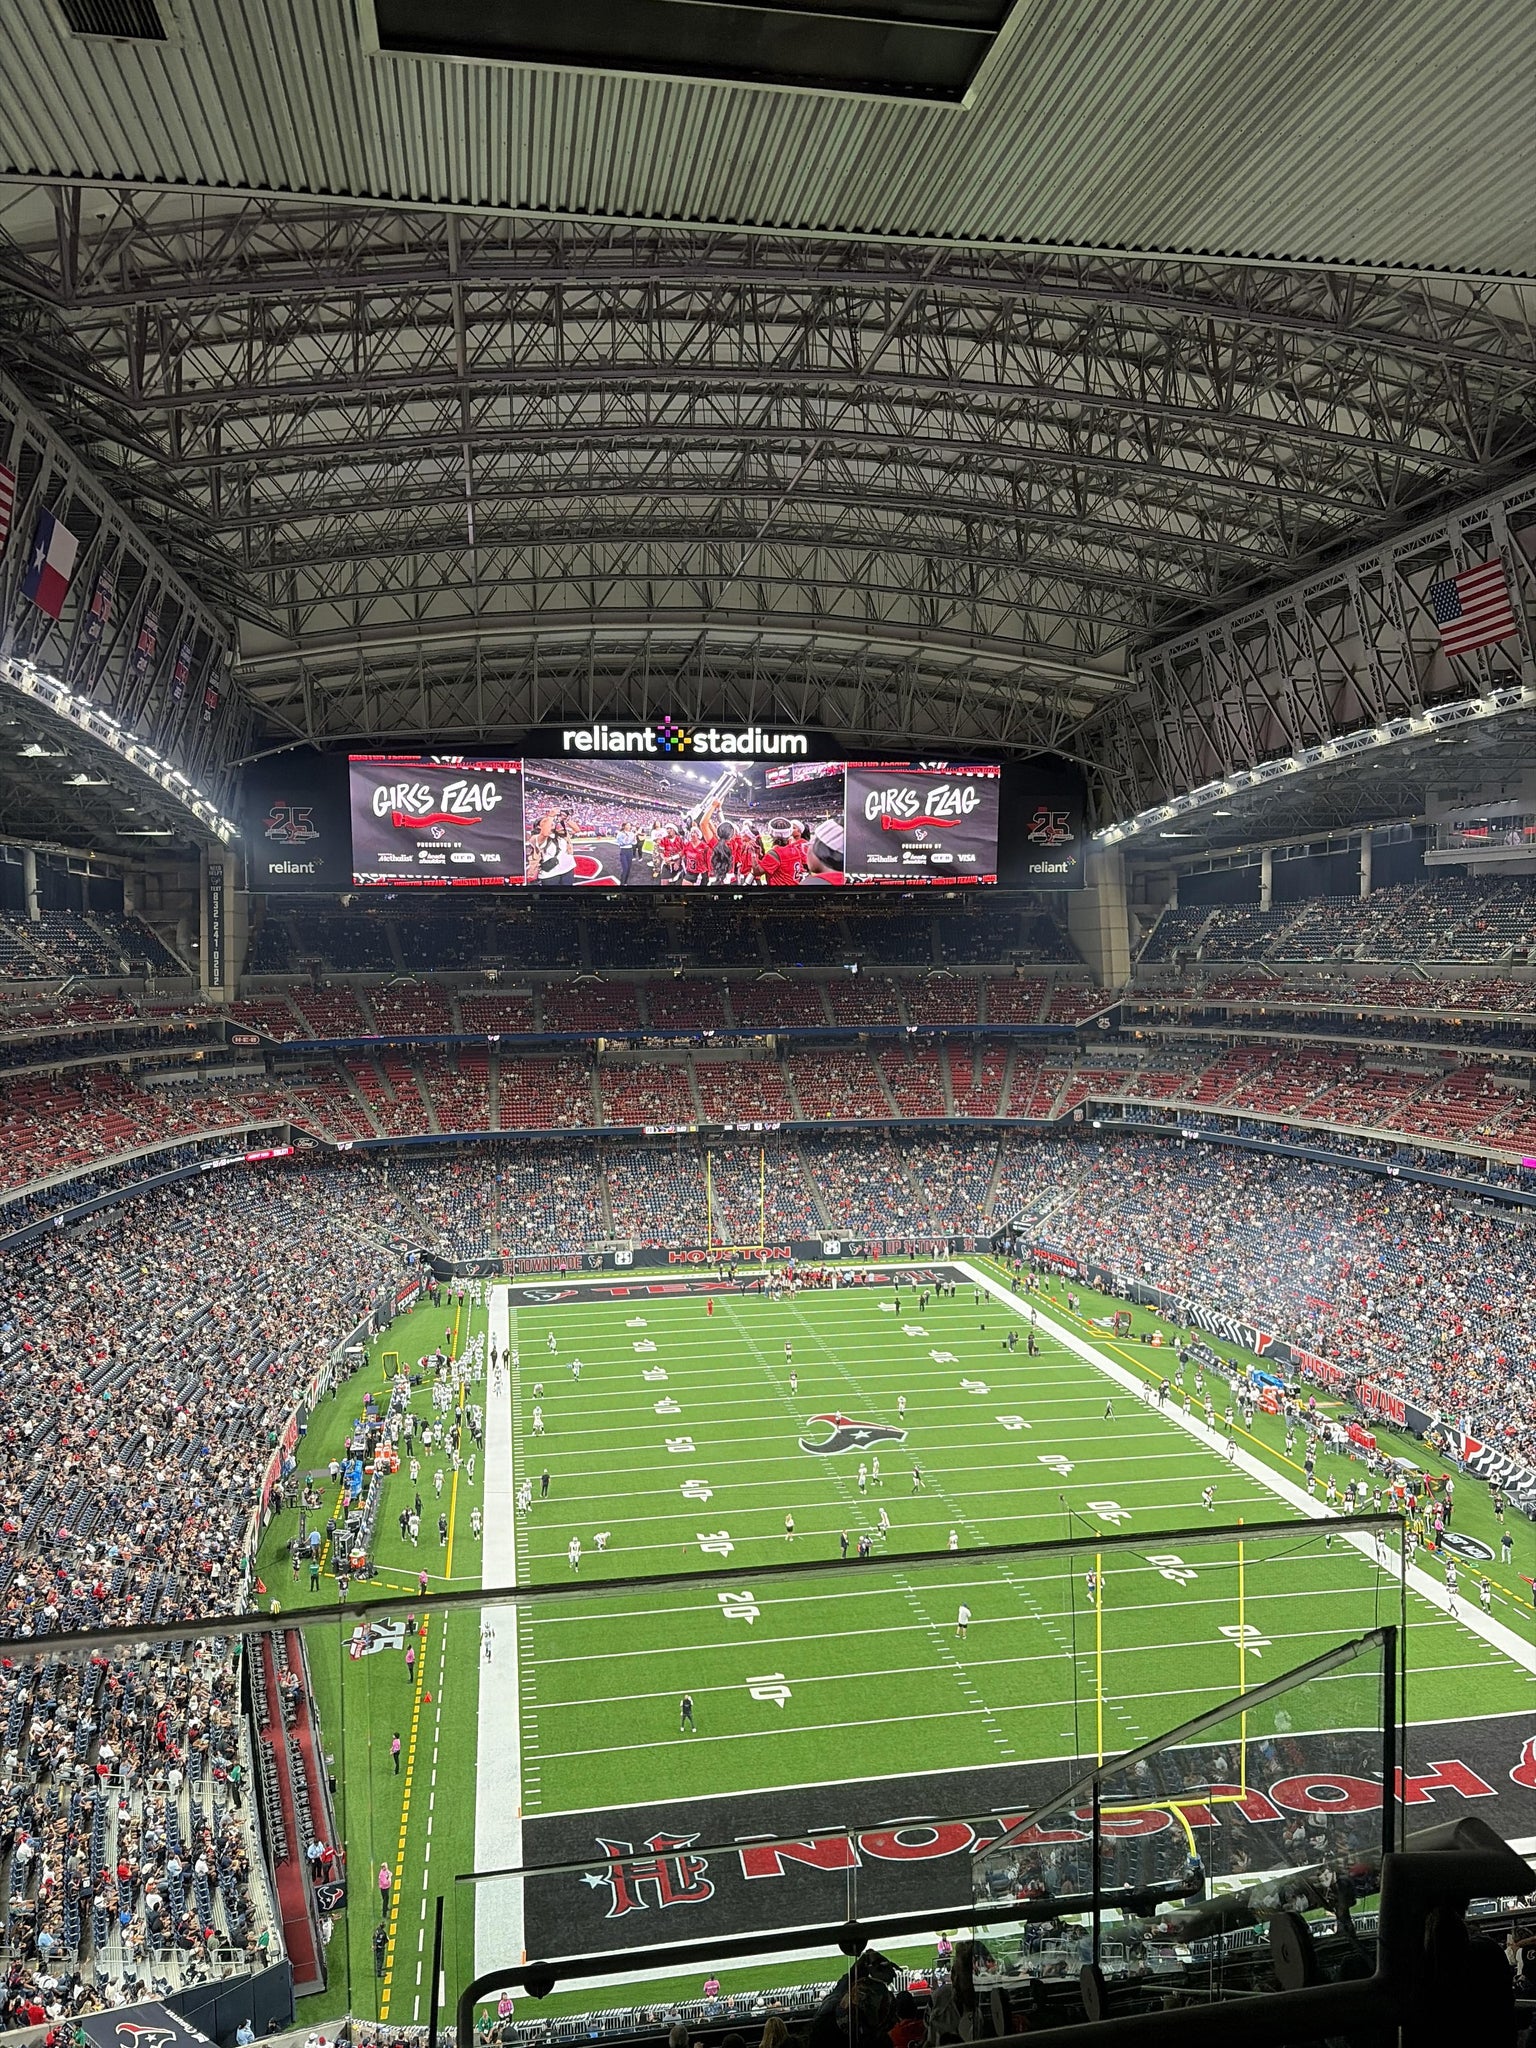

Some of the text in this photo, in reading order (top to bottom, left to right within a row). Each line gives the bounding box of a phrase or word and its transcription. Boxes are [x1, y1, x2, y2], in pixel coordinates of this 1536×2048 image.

[563, 725, 808, 754] reliant stadium
[373, 780, 502, 817] GIRLS FLAG
[865, 784, 980, 820] GIRLS FLAG
[269, 806, 314, 840] 25
[1032, 811, 1070, 843] 25
[269, 861, 315, 874] reliant
[378, 854, 414, 862] Methodist
[480, 853, 501, 862] VISA
[957, 854, 976, 862] VISA
[1029, 861, 1069, 873] reliant
[668, 1246, 792, 1263] HOUSTON
[886, 1240, 901, 1255] UP
[1033, 1247, 1078, 1269] HOUSTON
[518, 1257, 550, 1273] TOWN
[551, 1255, 583, 1271] MADE
[995, 1414, 1032, 1431] 50
[665, 1436, 696, 1453] 50
[1086, 1500, 1132, 1521] 30
[696, 1530, 735, 1554] 30
[1145, 1554, 1199, 1582] 20
[717, 1590, 760, 1620] 20
[1217, 1624, 1273, 1649] 10
[745, 1672, 793, 1701] 10
[733, 1759, 1500, 1880] HOUSTON
